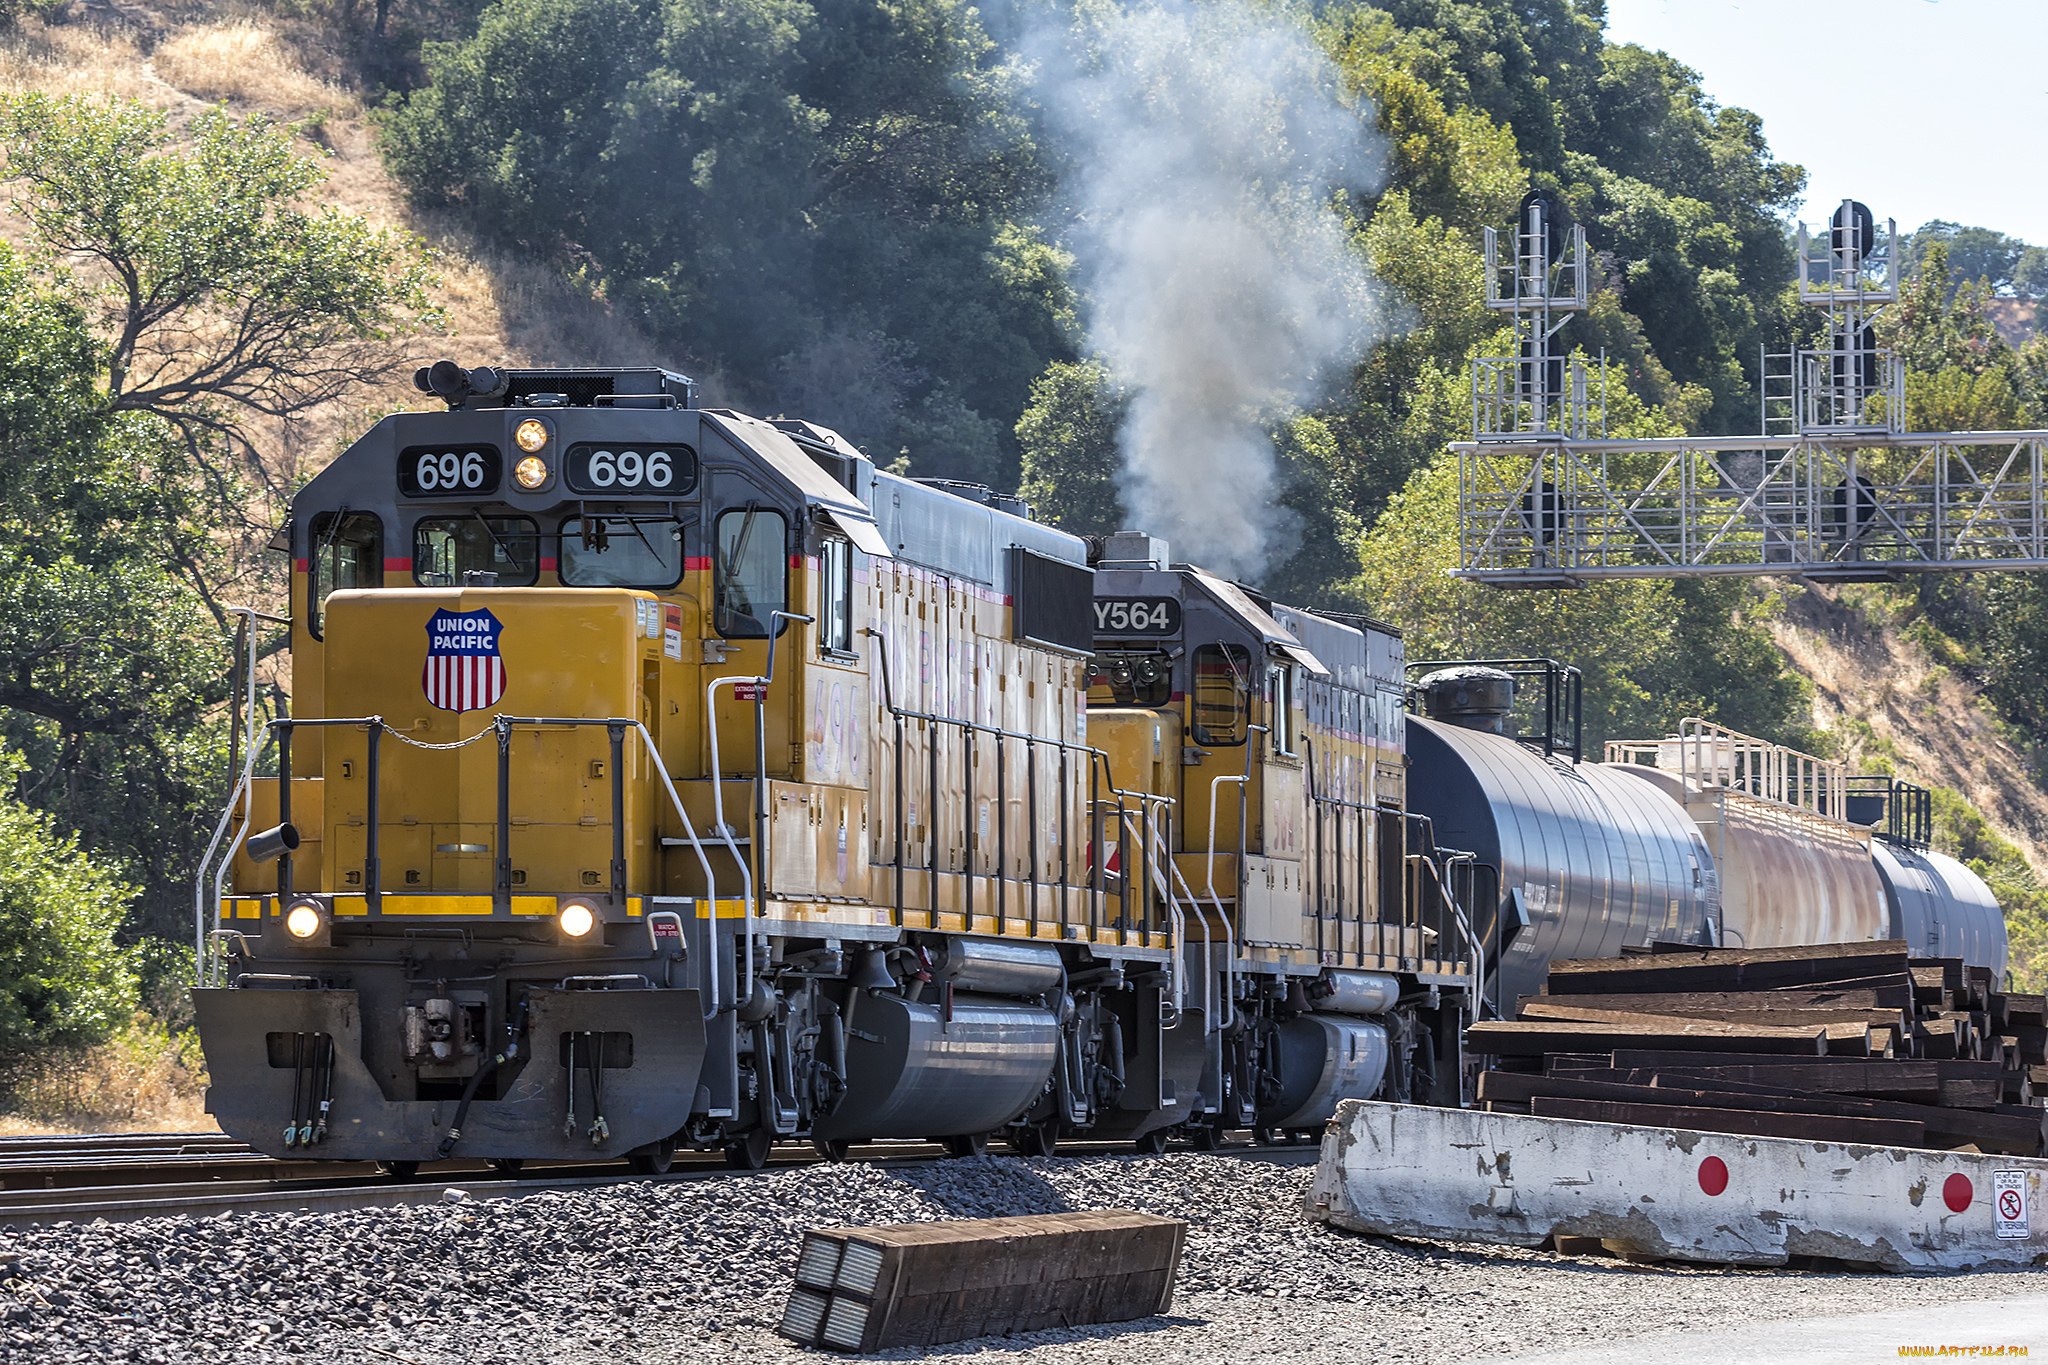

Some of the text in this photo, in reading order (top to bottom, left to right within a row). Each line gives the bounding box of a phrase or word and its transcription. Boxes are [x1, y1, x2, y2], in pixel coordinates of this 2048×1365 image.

[416, 452, 485, 490] 696
[588, 450, 673, 488] 696
[437, 618, 490, 632] UNION
[1093, 602, 1170, 630] Y564
[434, 635, 493, 649] PACIFIC
[813, 679, 861, 776] 696
